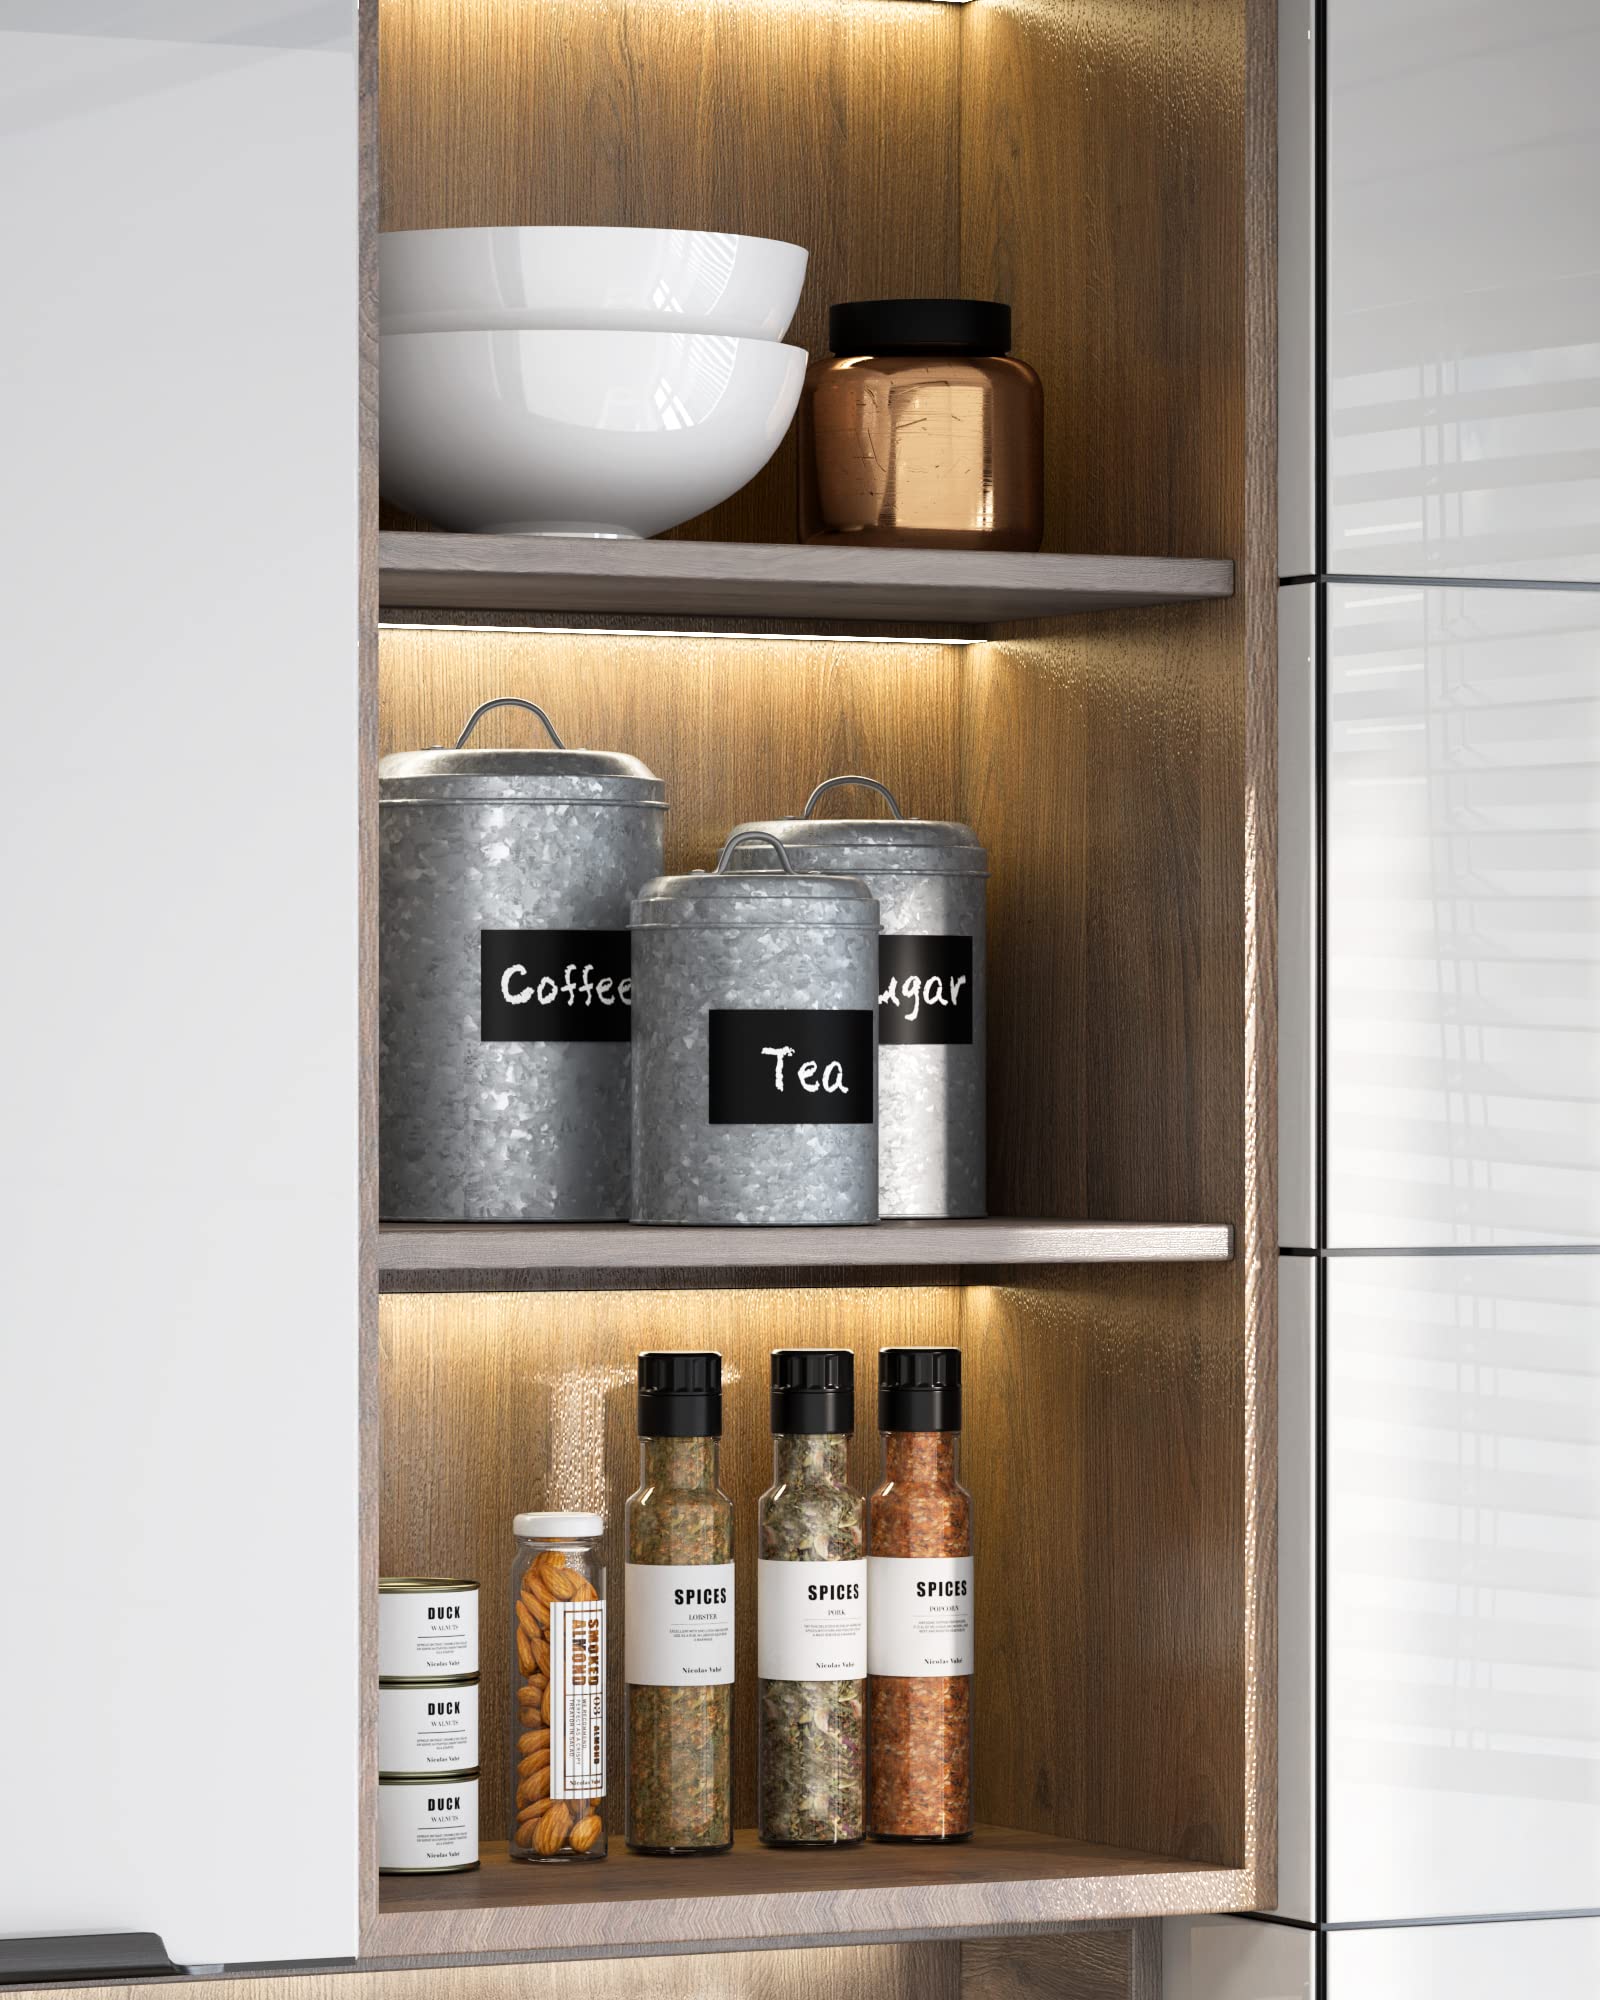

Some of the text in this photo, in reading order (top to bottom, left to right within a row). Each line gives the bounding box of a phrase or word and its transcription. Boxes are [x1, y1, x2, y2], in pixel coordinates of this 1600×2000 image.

[501, 963, 631, 1007] Coffee
[878, 974, 967, 1022] ugar
[761, 1046, 849, 1094] Tea
[674, 1587, 727, 1606] SPICES
[808, 1583, 860, 1601] SPICES
[916, 1579, 968, 1598] SPICES
[428, 1606, 460, 1620] DUCK
[688, 1612, 718, 1621] LOBSTER
[572, 1619, 587, 1686] ALMOND
[588, 1618, 599, 1686] SMOKED
[428, 1701, 460, 1715] DUCK
[428, 1796, 460, 1811] DUCK
